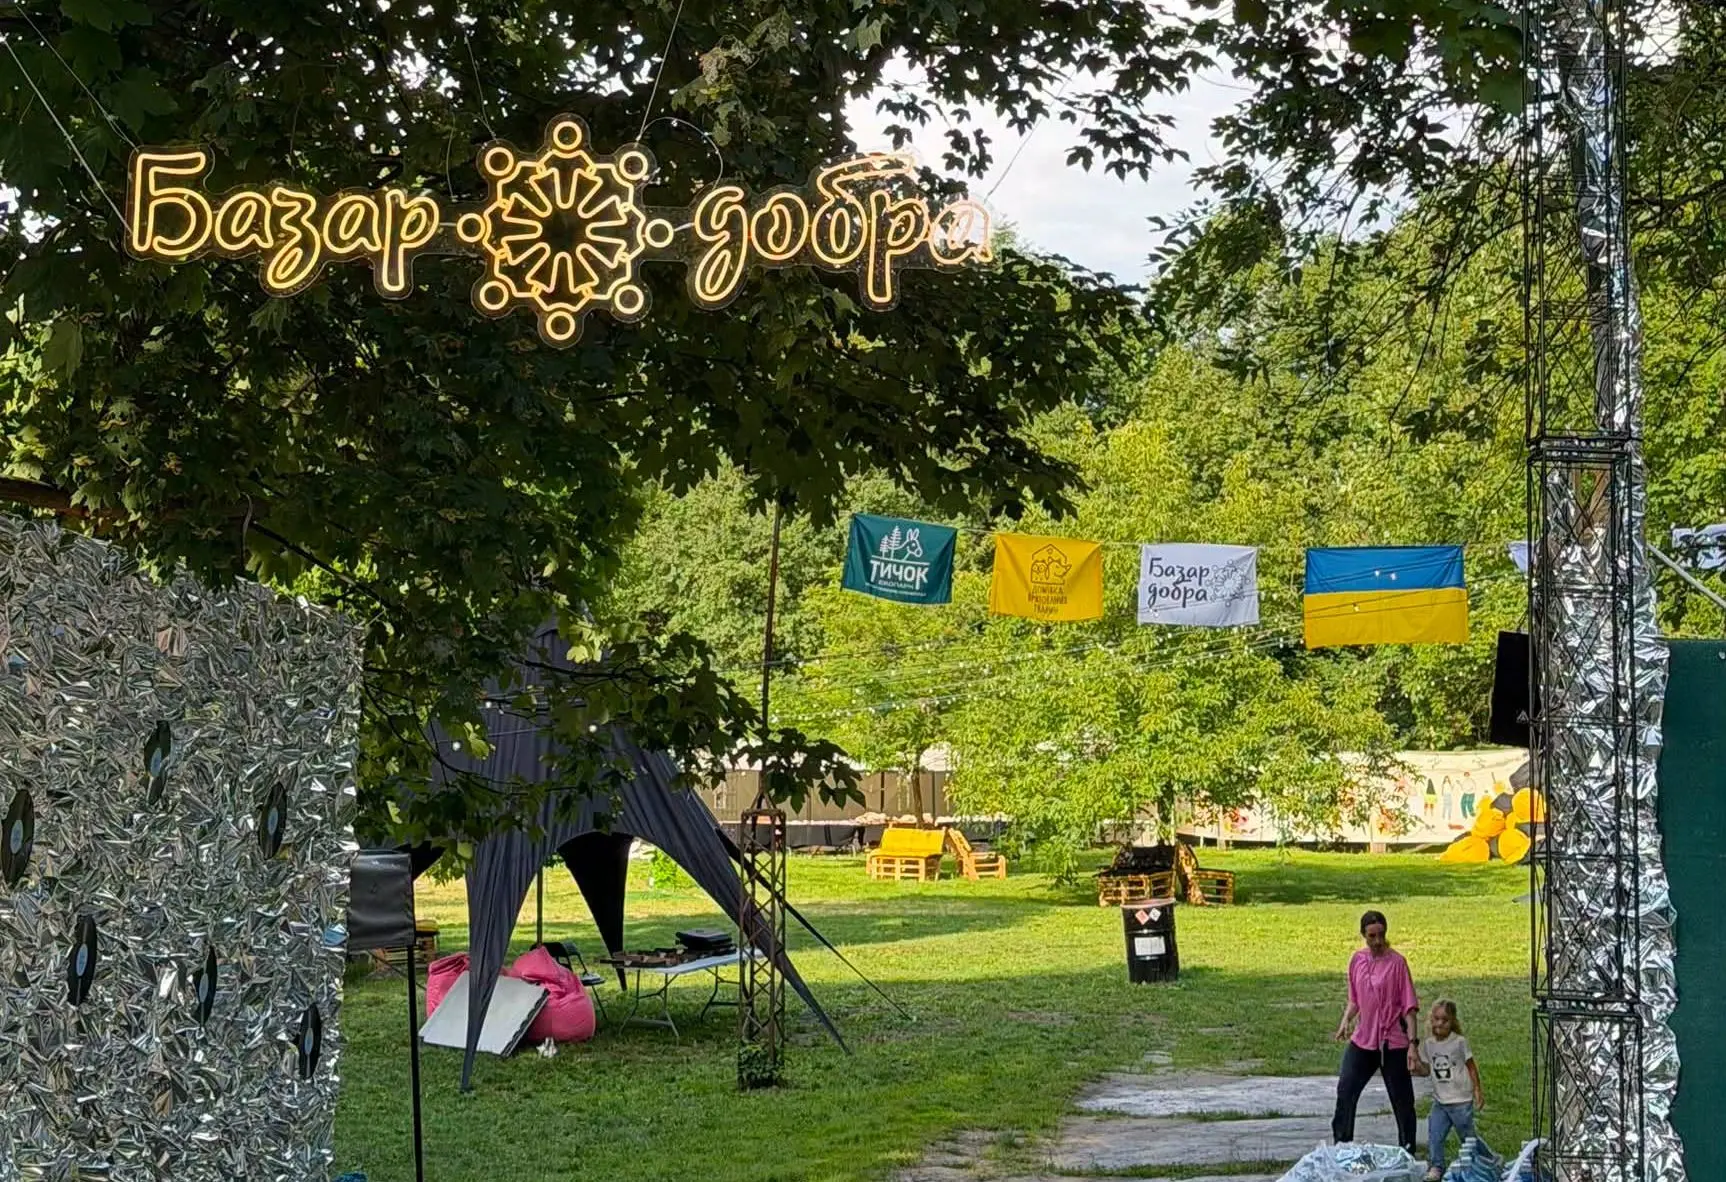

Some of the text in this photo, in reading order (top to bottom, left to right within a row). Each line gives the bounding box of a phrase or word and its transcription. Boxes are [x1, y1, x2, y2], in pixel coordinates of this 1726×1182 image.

[130, 150, 993, 303] Базар добра
[869, 559, 930, 591] ТИЧОК
[1148, 556, 1210, 587] Базар
[1147, 579, 1209, 609] добра
